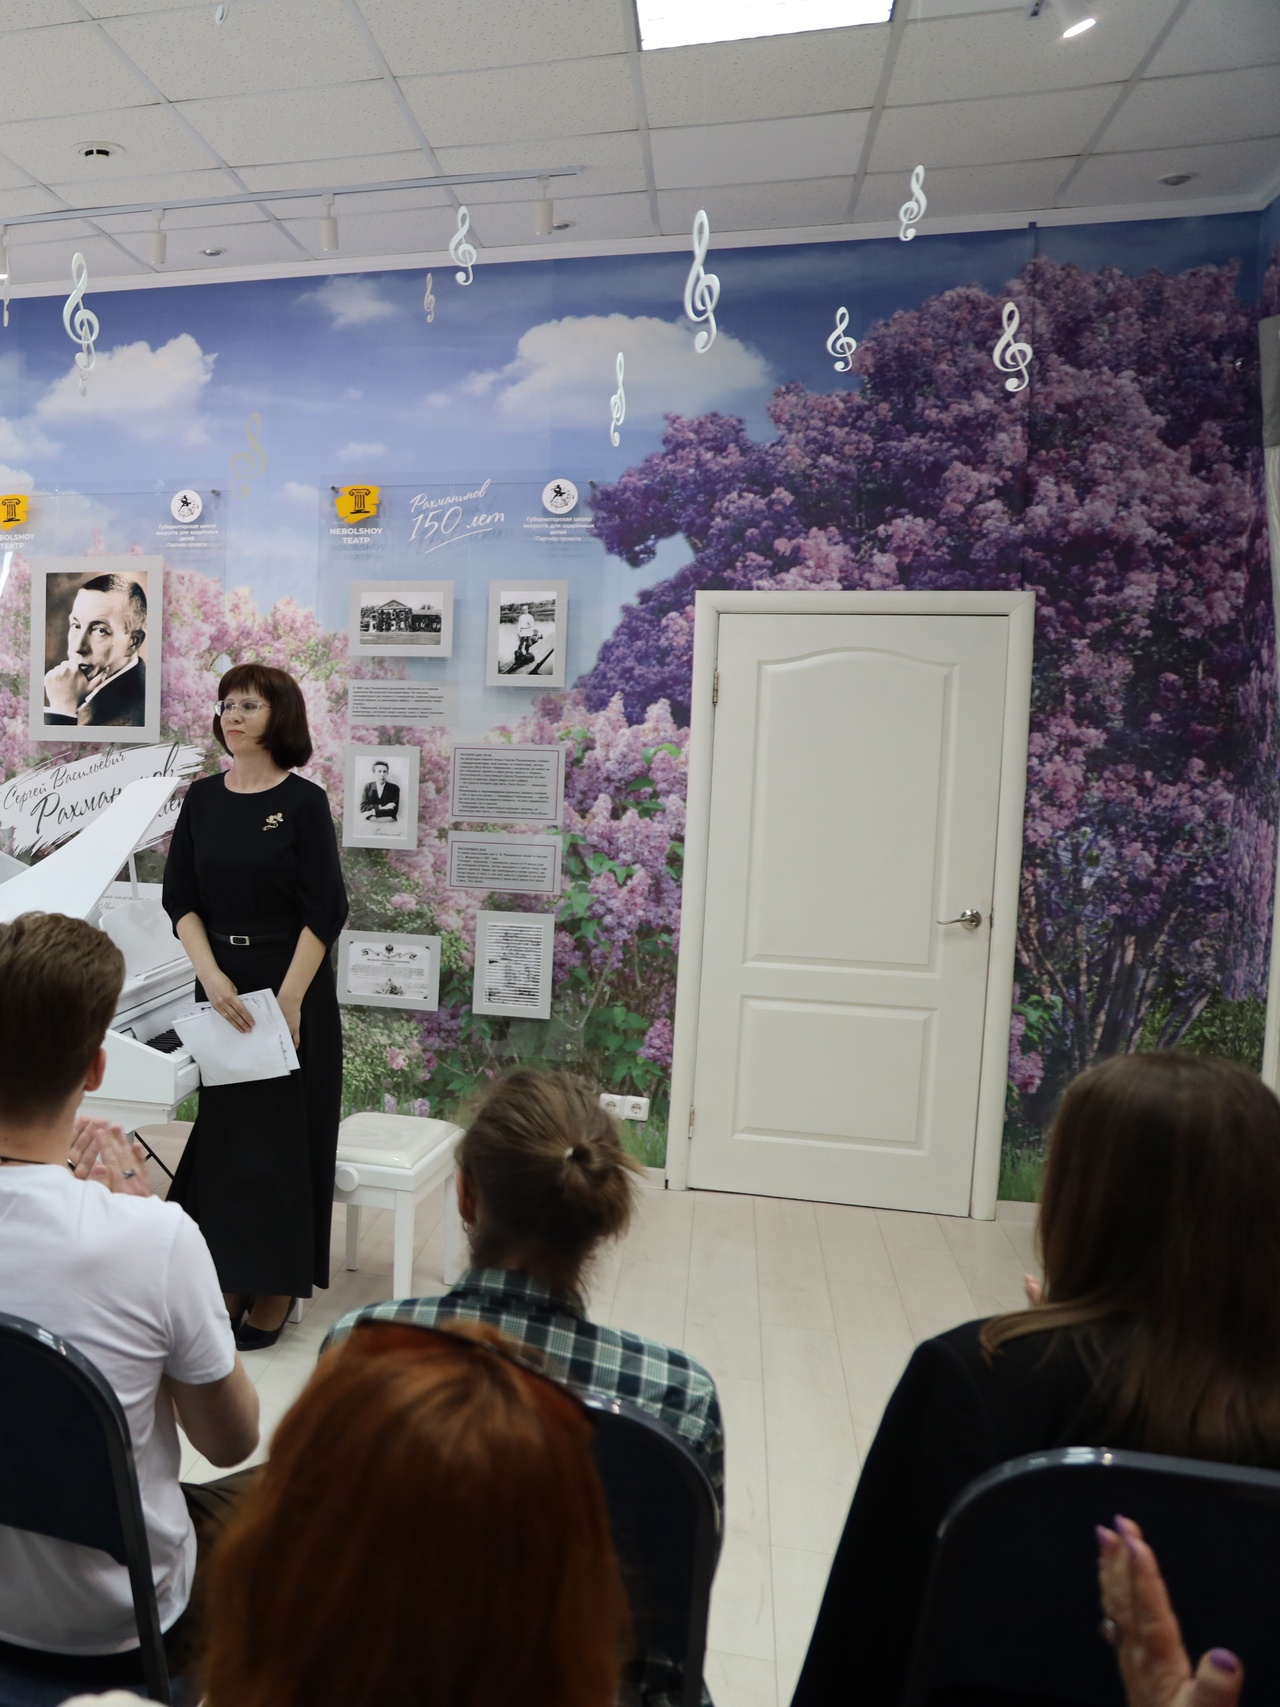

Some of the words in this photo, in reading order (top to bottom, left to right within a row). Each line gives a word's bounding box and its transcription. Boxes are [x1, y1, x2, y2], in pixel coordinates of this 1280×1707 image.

[409, 478, 492, 513] Рахманинов
[329, 527, 383, 535] NEBOLSHOY
[408, 506, 462, 542] 150
[466, 511, 505, 529] лет
[0, 542, 24, 550] ТЕАТР
[3, 782, 47, 812] Сергей
[50, 743, 126, 789] Васильевич
[30, 741, 180, 834] Рахманв
